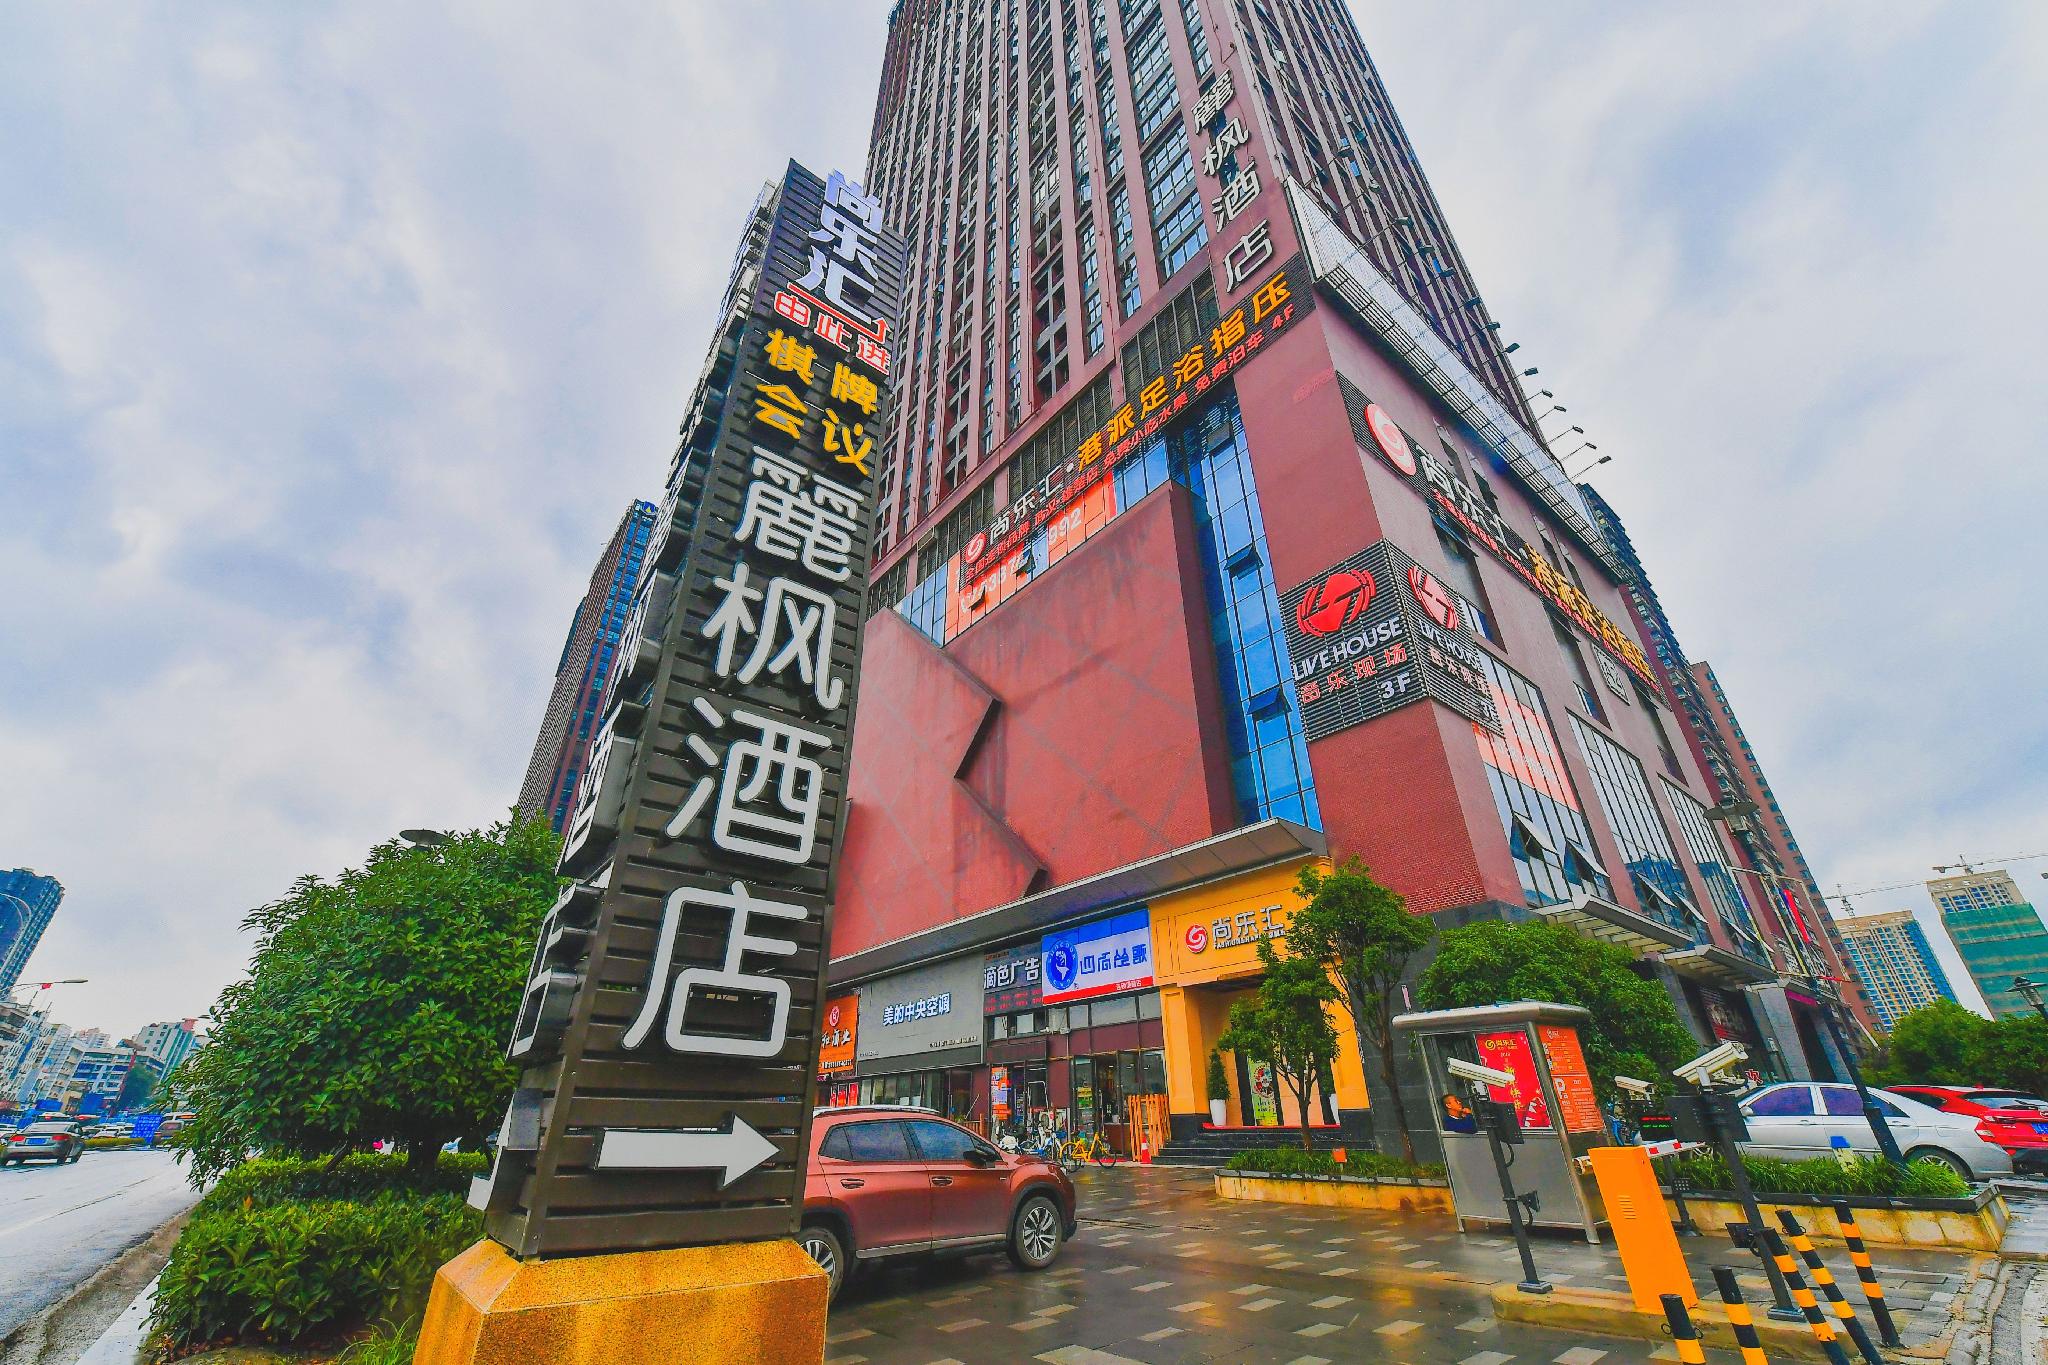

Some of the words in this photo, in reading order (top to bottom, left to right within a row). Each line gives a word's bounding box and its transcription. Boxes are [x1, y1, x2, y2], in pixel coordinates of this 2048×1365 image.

[1191, 69, 1274, 293] 麗枫酒店
[796, 168, 882, 322] 尚乐汇
[764, 328, 878, 415] 棋牌
[774, 290, 890, 375] 由此进
[755, 383, 873, 476] 会议
[1103, 391, 1188, 469] 免费小吃水果
[1195, 329, 1265, 394] 免费泊车
[1271, 303, 1294, 329] 4F
[1300, 642, 1408, 704] 音乐现场
[1381, 671, 1412, 700] 3F
[621, 443, 863, 1058] 麗枫酒店
[1212, 904, 1285, 942] 尚乐汇
[882, 992, 951, 1027] 美的中央空调
